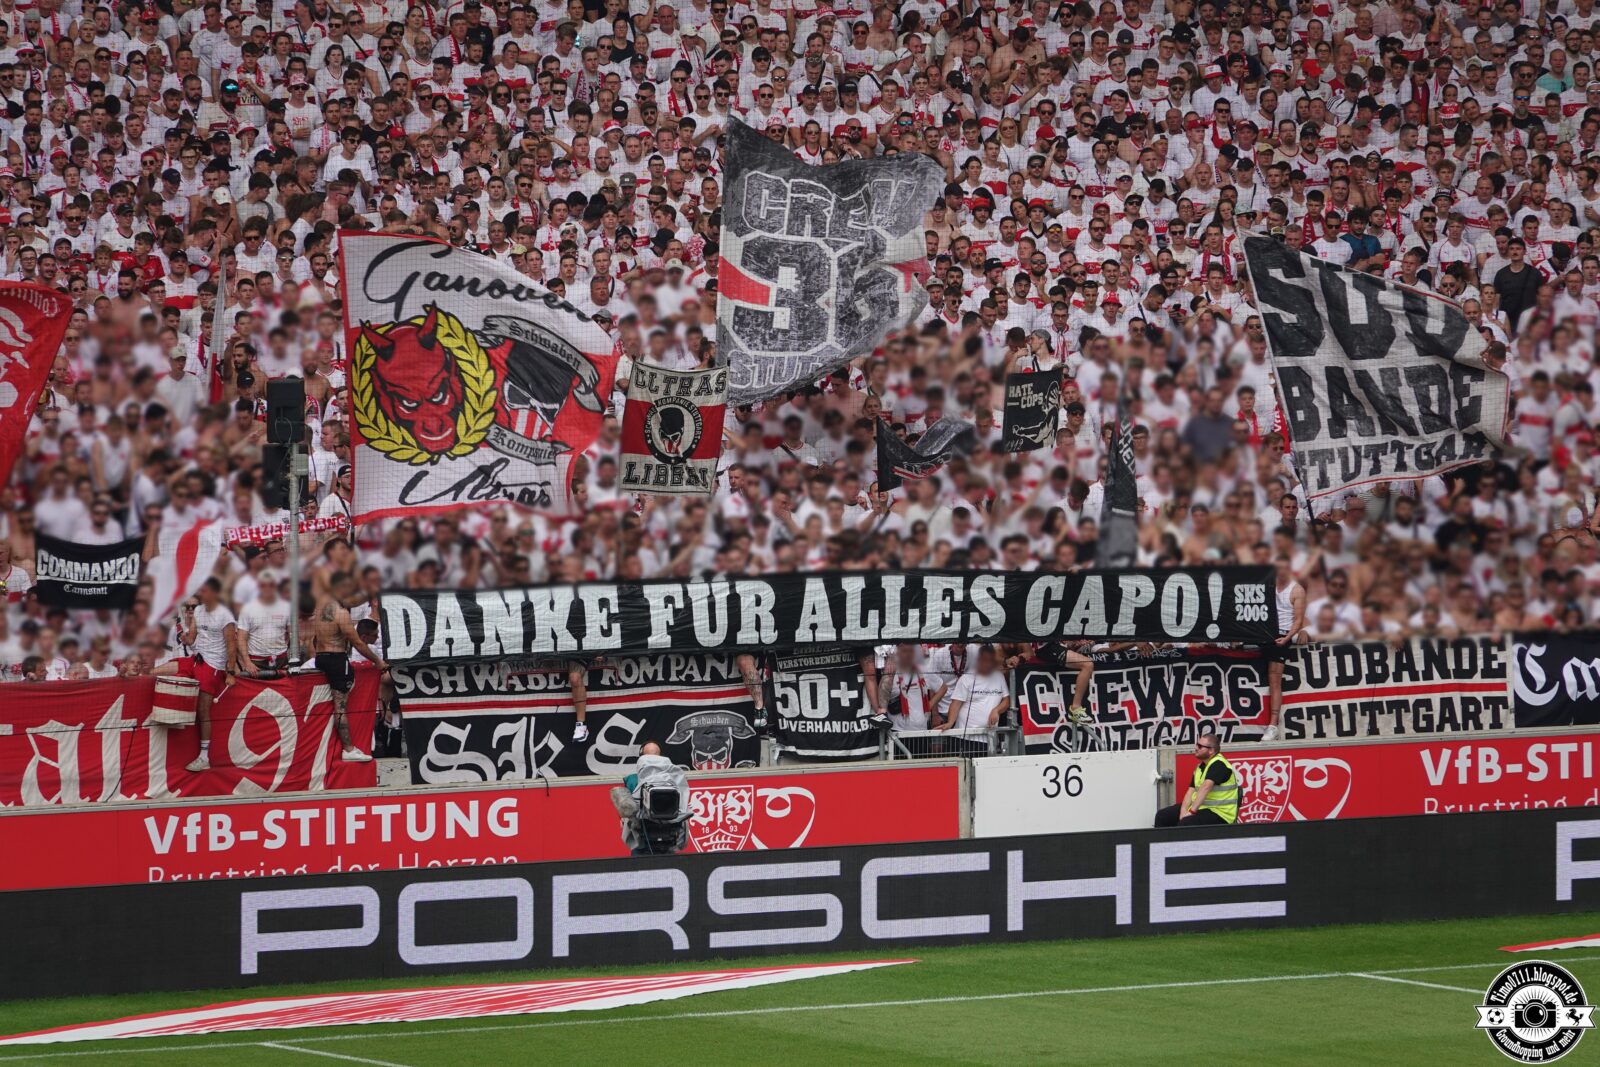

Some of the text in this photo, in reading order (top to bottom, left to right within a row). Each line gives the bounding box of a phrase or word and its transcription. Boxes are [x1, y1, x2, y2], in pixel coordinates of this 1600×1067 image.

[508, 320, 582, 370] Schwaben
[634, 366, 727, 397] ULTRAS
[1009, 382, 1034, 398] HATE
[1020, 392, 1044, 409] COPS
[1277, 362, 1485, 442] BANDE
[37, 548, 140, 581] COMMANDO
[63, 583, 108, 595] Cannstatt
[1233, 584, 1266, 604] SKS
[382, 584, 621, 660] DANKE
[795, 575, 1006, 642] ALLES
[1025, 571, 1224, 640] CAPO!
[1235, 604, 1269, 622] 2006
[393, 655, 762, 695] SCHWABE KOMPANI
[1284, 696, 1509, 740] STUTTGART
[226, 684, 337, 794] 97
[1042, 764, 1084, 798] 36
[144, 797, 519, 854] VfB-STIFTUNG
[241, 836, 1287, 974] PORSCHE
